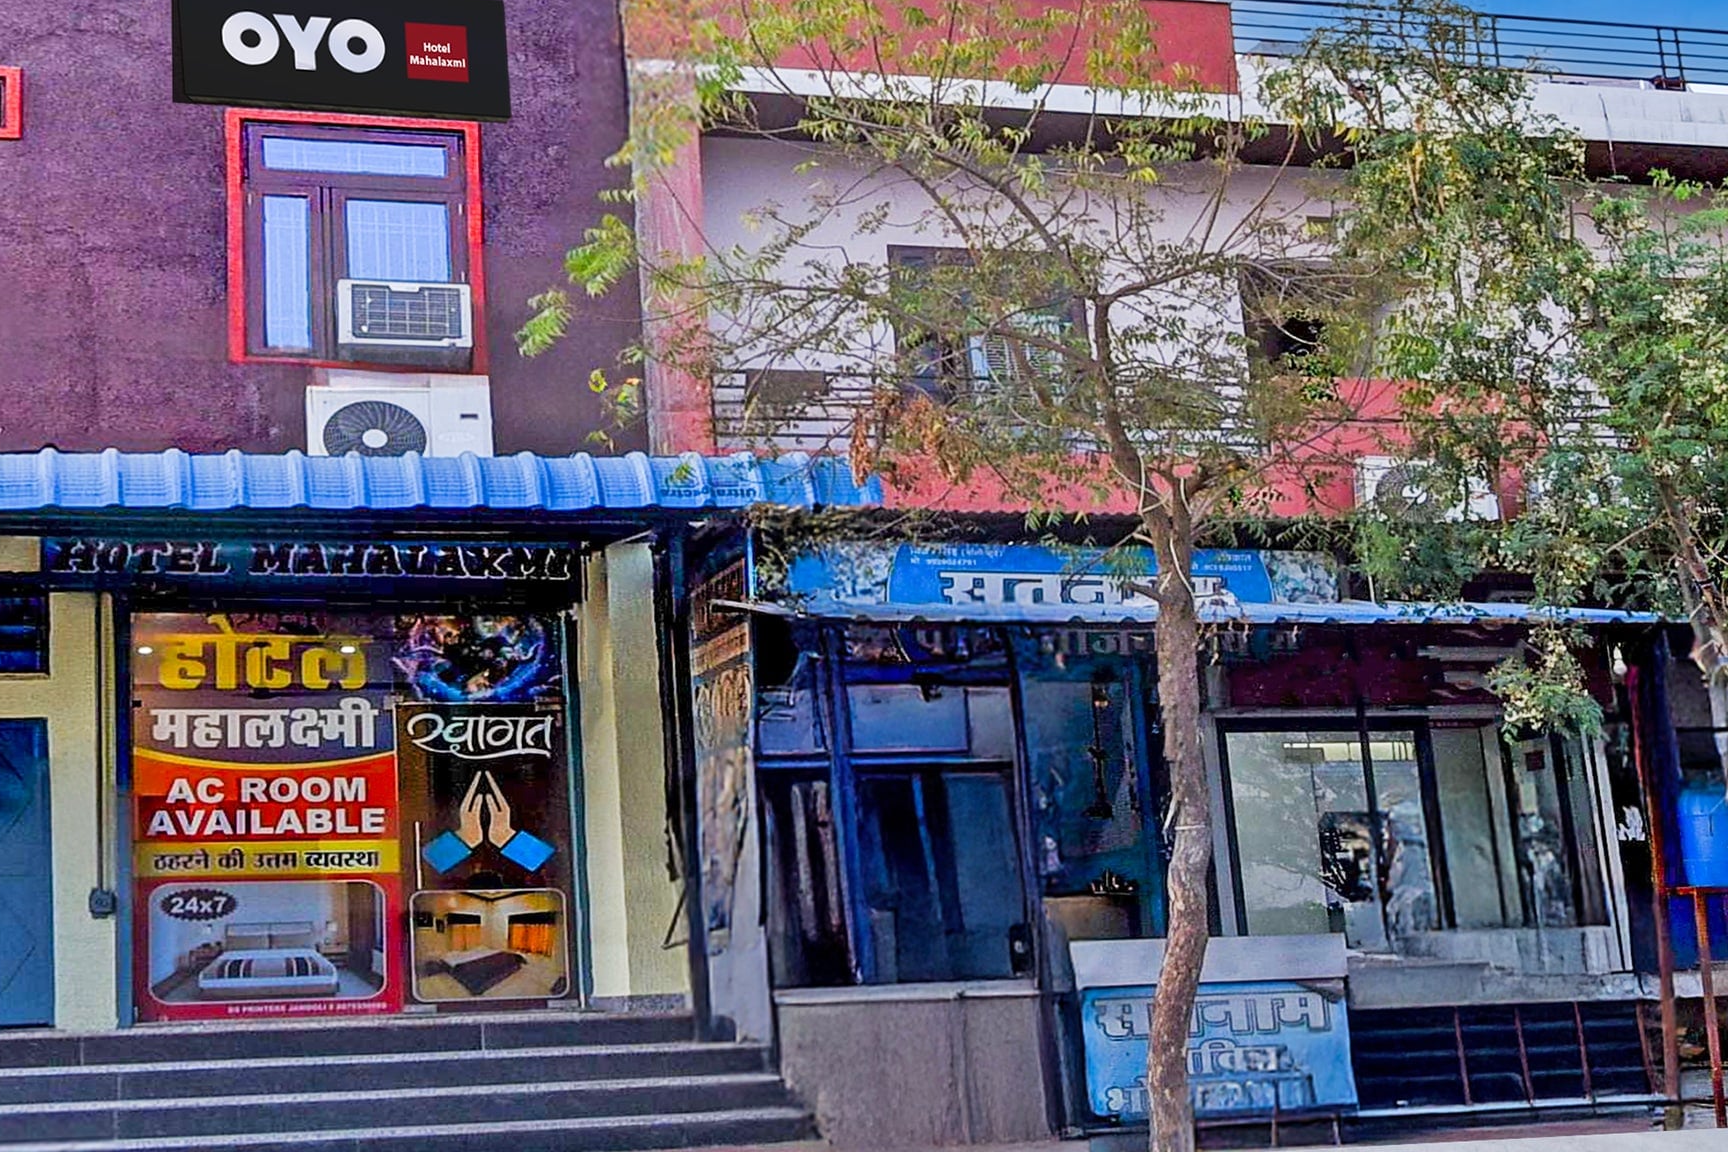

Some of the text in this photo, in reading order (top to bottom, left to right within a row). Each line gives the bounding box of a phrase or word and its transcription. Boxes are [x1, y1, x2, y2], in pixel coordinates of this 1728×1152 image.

[221, 11, 386, 73] OYO
[423, 42, 451, 54] Hotel
[409, 54, 466, 68] Mahalaxmi
[51, 539, 231, 575] HOTEL
[158, 613, 373, 690] होटल
[150, 697, 379, 748] महालक्ष्मी
[407, 713, 554, 759] स्वागत
[166, 777, 367, 804] AC ROOM
[146, 808, 386, 836] AVAILABLE
[154, 849, 209, 870] ठहरने
[218, 849, 244, 870] की
[170, 897, 227, 914] 24x7
[1094, 993, 1330, 1038] सनाम
